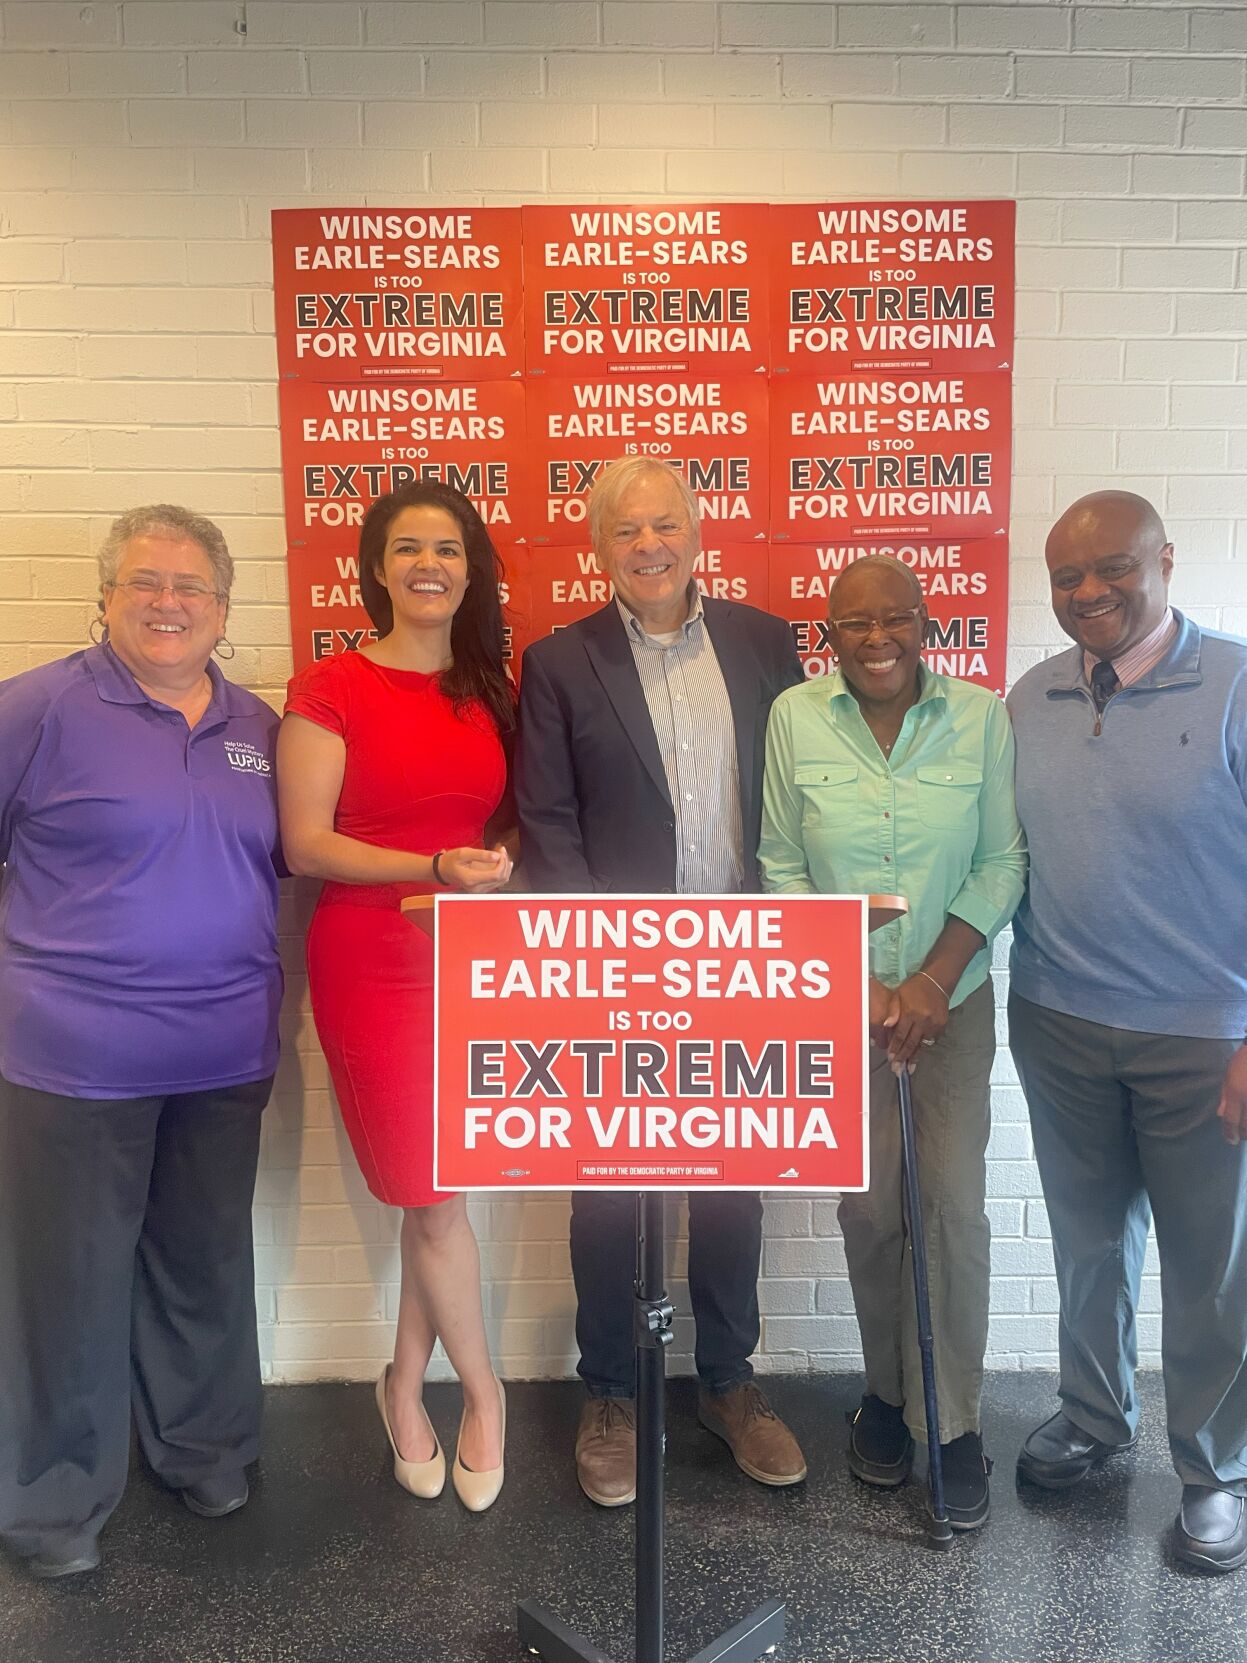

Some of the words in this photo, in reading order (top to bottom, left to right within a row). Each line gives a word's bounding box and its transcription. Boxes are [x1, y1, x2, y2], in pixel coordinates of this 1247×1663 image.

[319, 215, 472, 240] WINSOME
[570, 211, 721, 237] WINSOME
[817, 208, 967, 235] WINSOME
[295, 244, 500, 270] EARLE-SEARS
[544, 240, 748, 267] EARLE-SEARS
[791, 237, 993, 266] EARLE-SEARS
[374, 276, 388, 289] IS
[390, 275, 423, 288] TOO
[623, 272, 636, 285] IS
[638, 271, 671, 285] TOO
[869, 269, 882, 282] IS
[884, 269, 917, 282] TOO
[295, 292, 504, 329] EXTREME
[544, 288, 750, 326] EXTREME
[790, 284, 995, 325] EXTREME
[296, 332, 357, 358] FOR
[363, 331, 507, 357] VIRGINIA
[543, 329, 604, 355] FOR
[611, 327, 752, 354] VIRGINIA
[788, 327, 849, 353] FOR
[856, 323, 996, 351] VIRGINIA
[327, 388, 478, 413] WINSOME
[573, 383, 721, 408] WINSOME
[816, 380, 964, 406] WINSOME
[303, 416, 505, 442] EARLE-SEARS
[548, 411, 748, 438] EARLE-SEARS
[791, 407, 990, 435] EARLE-SEARS
[381, 447, 395, 460] IS
[397, 447, 429, 459] TOO
[625, 442, 638, 455] IS
[640, 442, 672, 455] TOO
[867, 439, 881, 452] IS
[883, 438, 915, 451] TOO
[548, 457, 750, 495] EXME
[790, 452, 992, 493] EXTREME
[304, 502, 365, 527] FOR
[547, 498, 587, 523] FO
[788, 494, 849, 520] FOR
[855, 490, 993, 517] VIRGINIA
[816, 545, 962, 571] WIOME
[789, 617, 989, 654] EXME
[518, 910, 782, 948] WINSOME
[472, 959, 830, 998] EARLE-SEARS
[610, 1011, 630, 1030] IS
[637, 1011, 692, 1030] TOO
[468, 1040, 833, 1098] EXTREME
[465, 1107, 571, 1148] FOR
[586, 1107, 837, 1148] VIRGINIA
[582, 1166, 596, 1176] PAID
[597, 1166, 608, 1176] FOR
[609, 1166, 616, 1176] BY
[618, 1166, 628, 1176] THE
[630, 1166, 665, 1176] DEMOCRATIC
[666, 1166, 684, 1176] PARTY
[685, 1166, 693, 1176] OF
[694, 1166, 718, 1176] VIRGINIA
